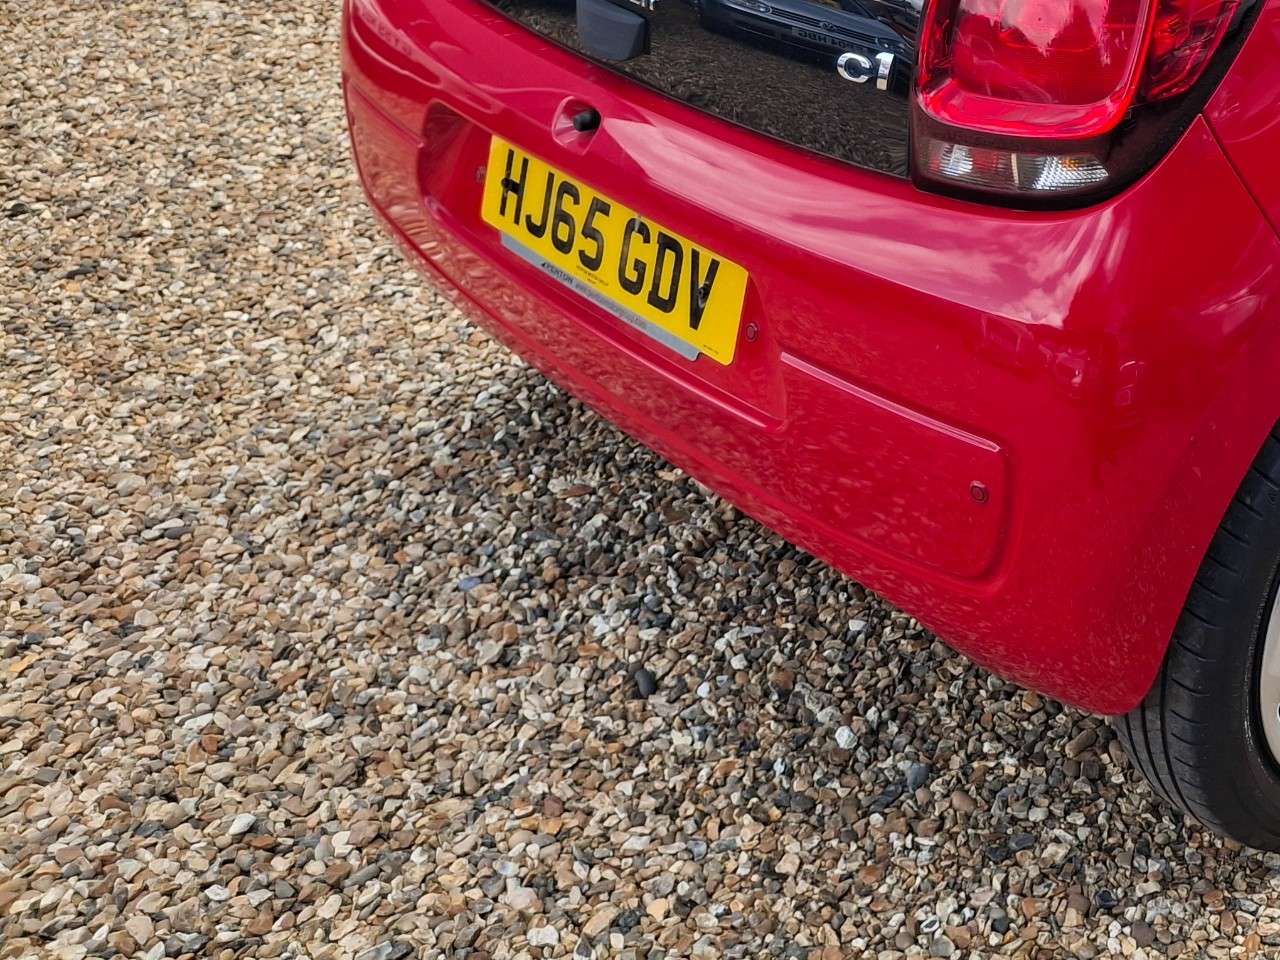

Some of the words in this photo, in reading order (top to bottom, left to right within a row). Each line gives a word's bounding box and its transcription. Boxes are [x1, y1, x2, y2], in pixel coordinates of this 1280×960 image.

[836, 50, 896, 91] C1
[499, 148, 611, 273] HJ65
[617, 217, 721, 331] GDV
